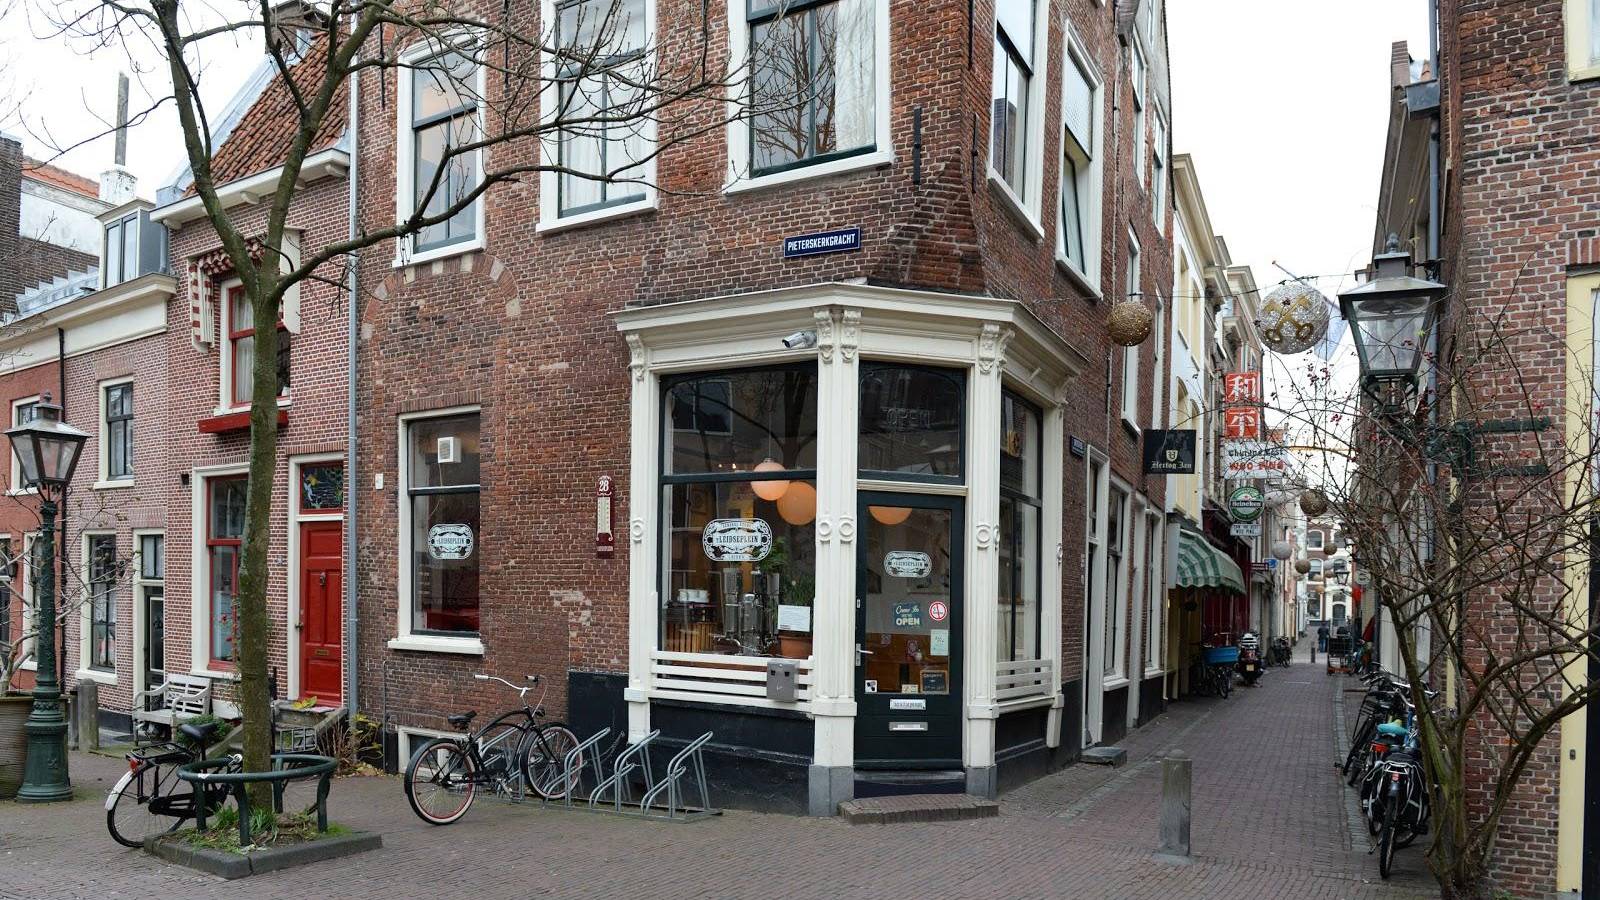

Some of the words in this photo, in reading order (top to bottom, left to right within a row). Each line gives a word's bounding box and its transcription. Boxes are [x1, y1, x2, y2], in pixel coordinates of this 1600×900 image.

[787, 233, 856, 251] PIETERSKERKGRACHT
[1151, 460, 1177, 470] Hertog
[1179, 461, 1192, 469] Jan
[599, 480, 609, 492] 28
[719, 535, 759, 543] LEIDSEPLEIN
[895, 617, 920, 626] OPEN
